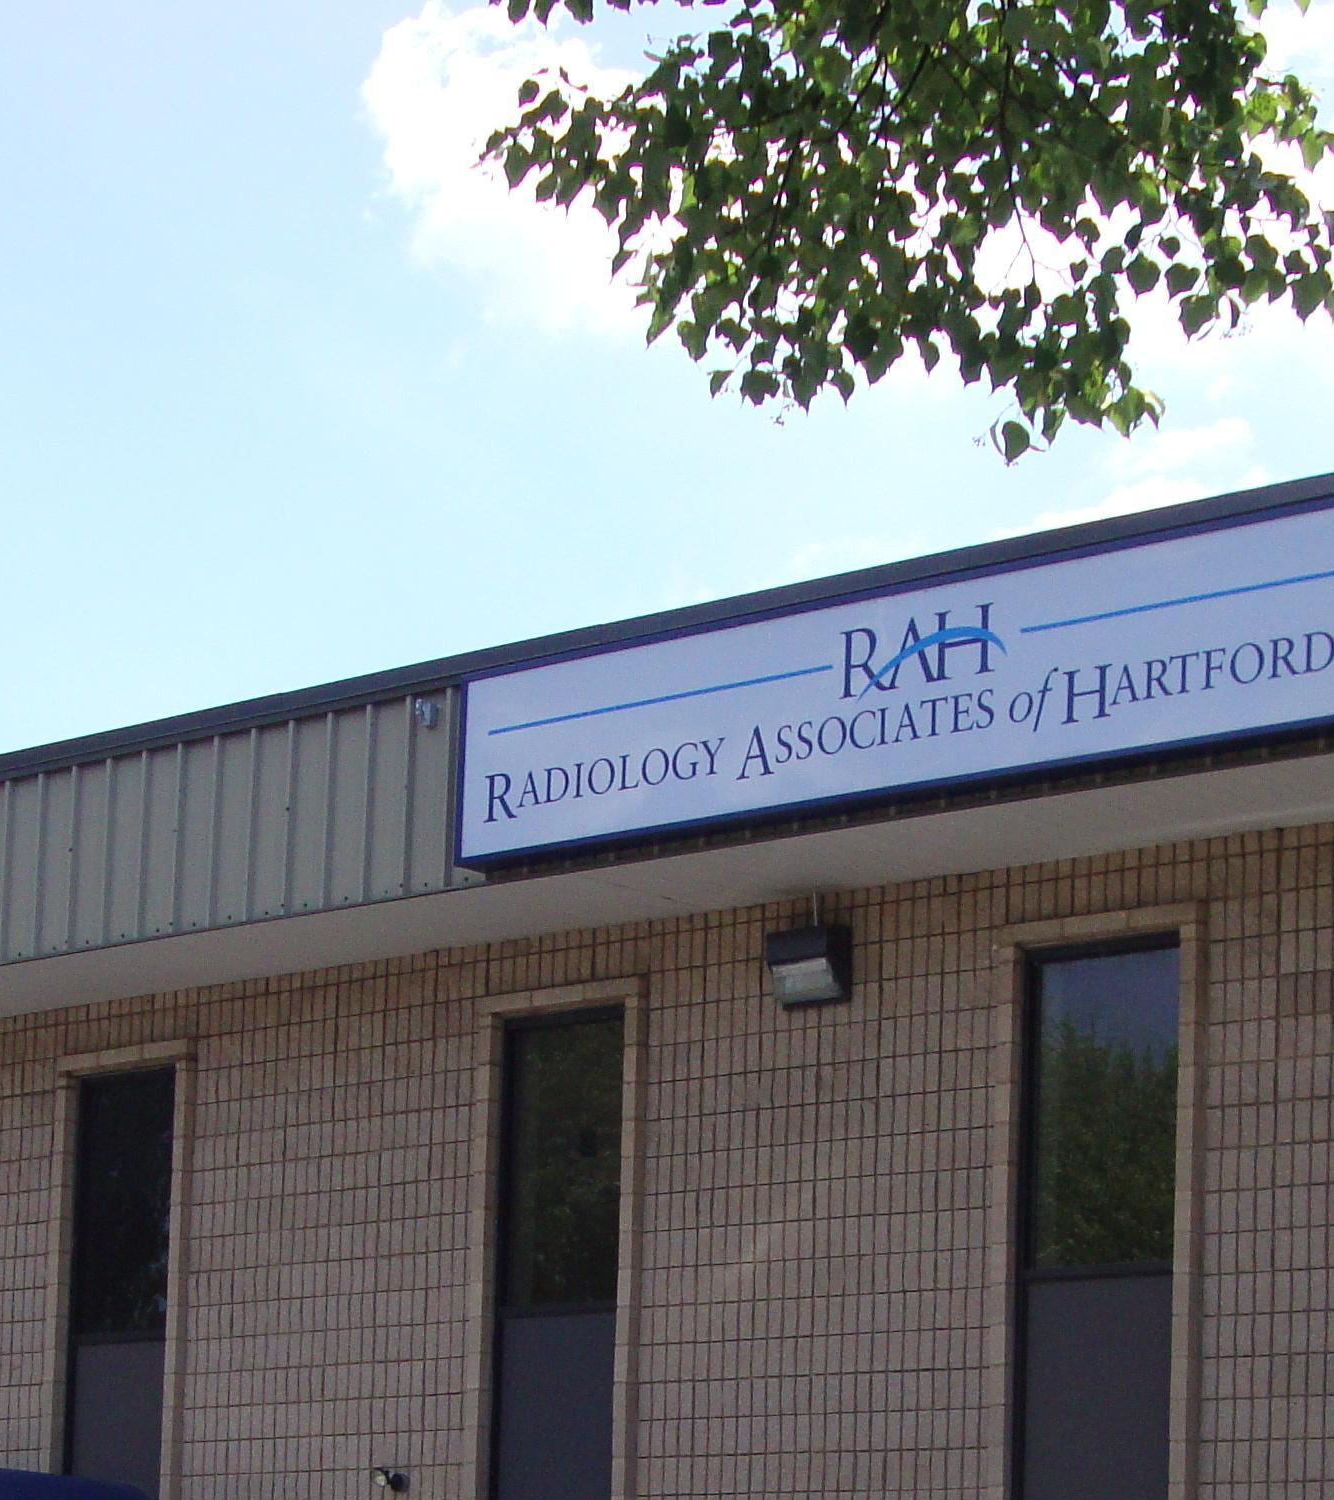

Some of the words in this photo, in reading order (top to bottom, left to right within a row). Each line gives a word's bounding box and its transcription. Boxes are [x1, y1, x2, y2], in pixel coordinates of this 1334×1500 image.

[839, 602, 995, 700] RAH
[483, 737, 727, 824] RADIOLOGY
[736, 687, 995, 782] ASSOCIATES
[1008, 667, 1059, 732] of
